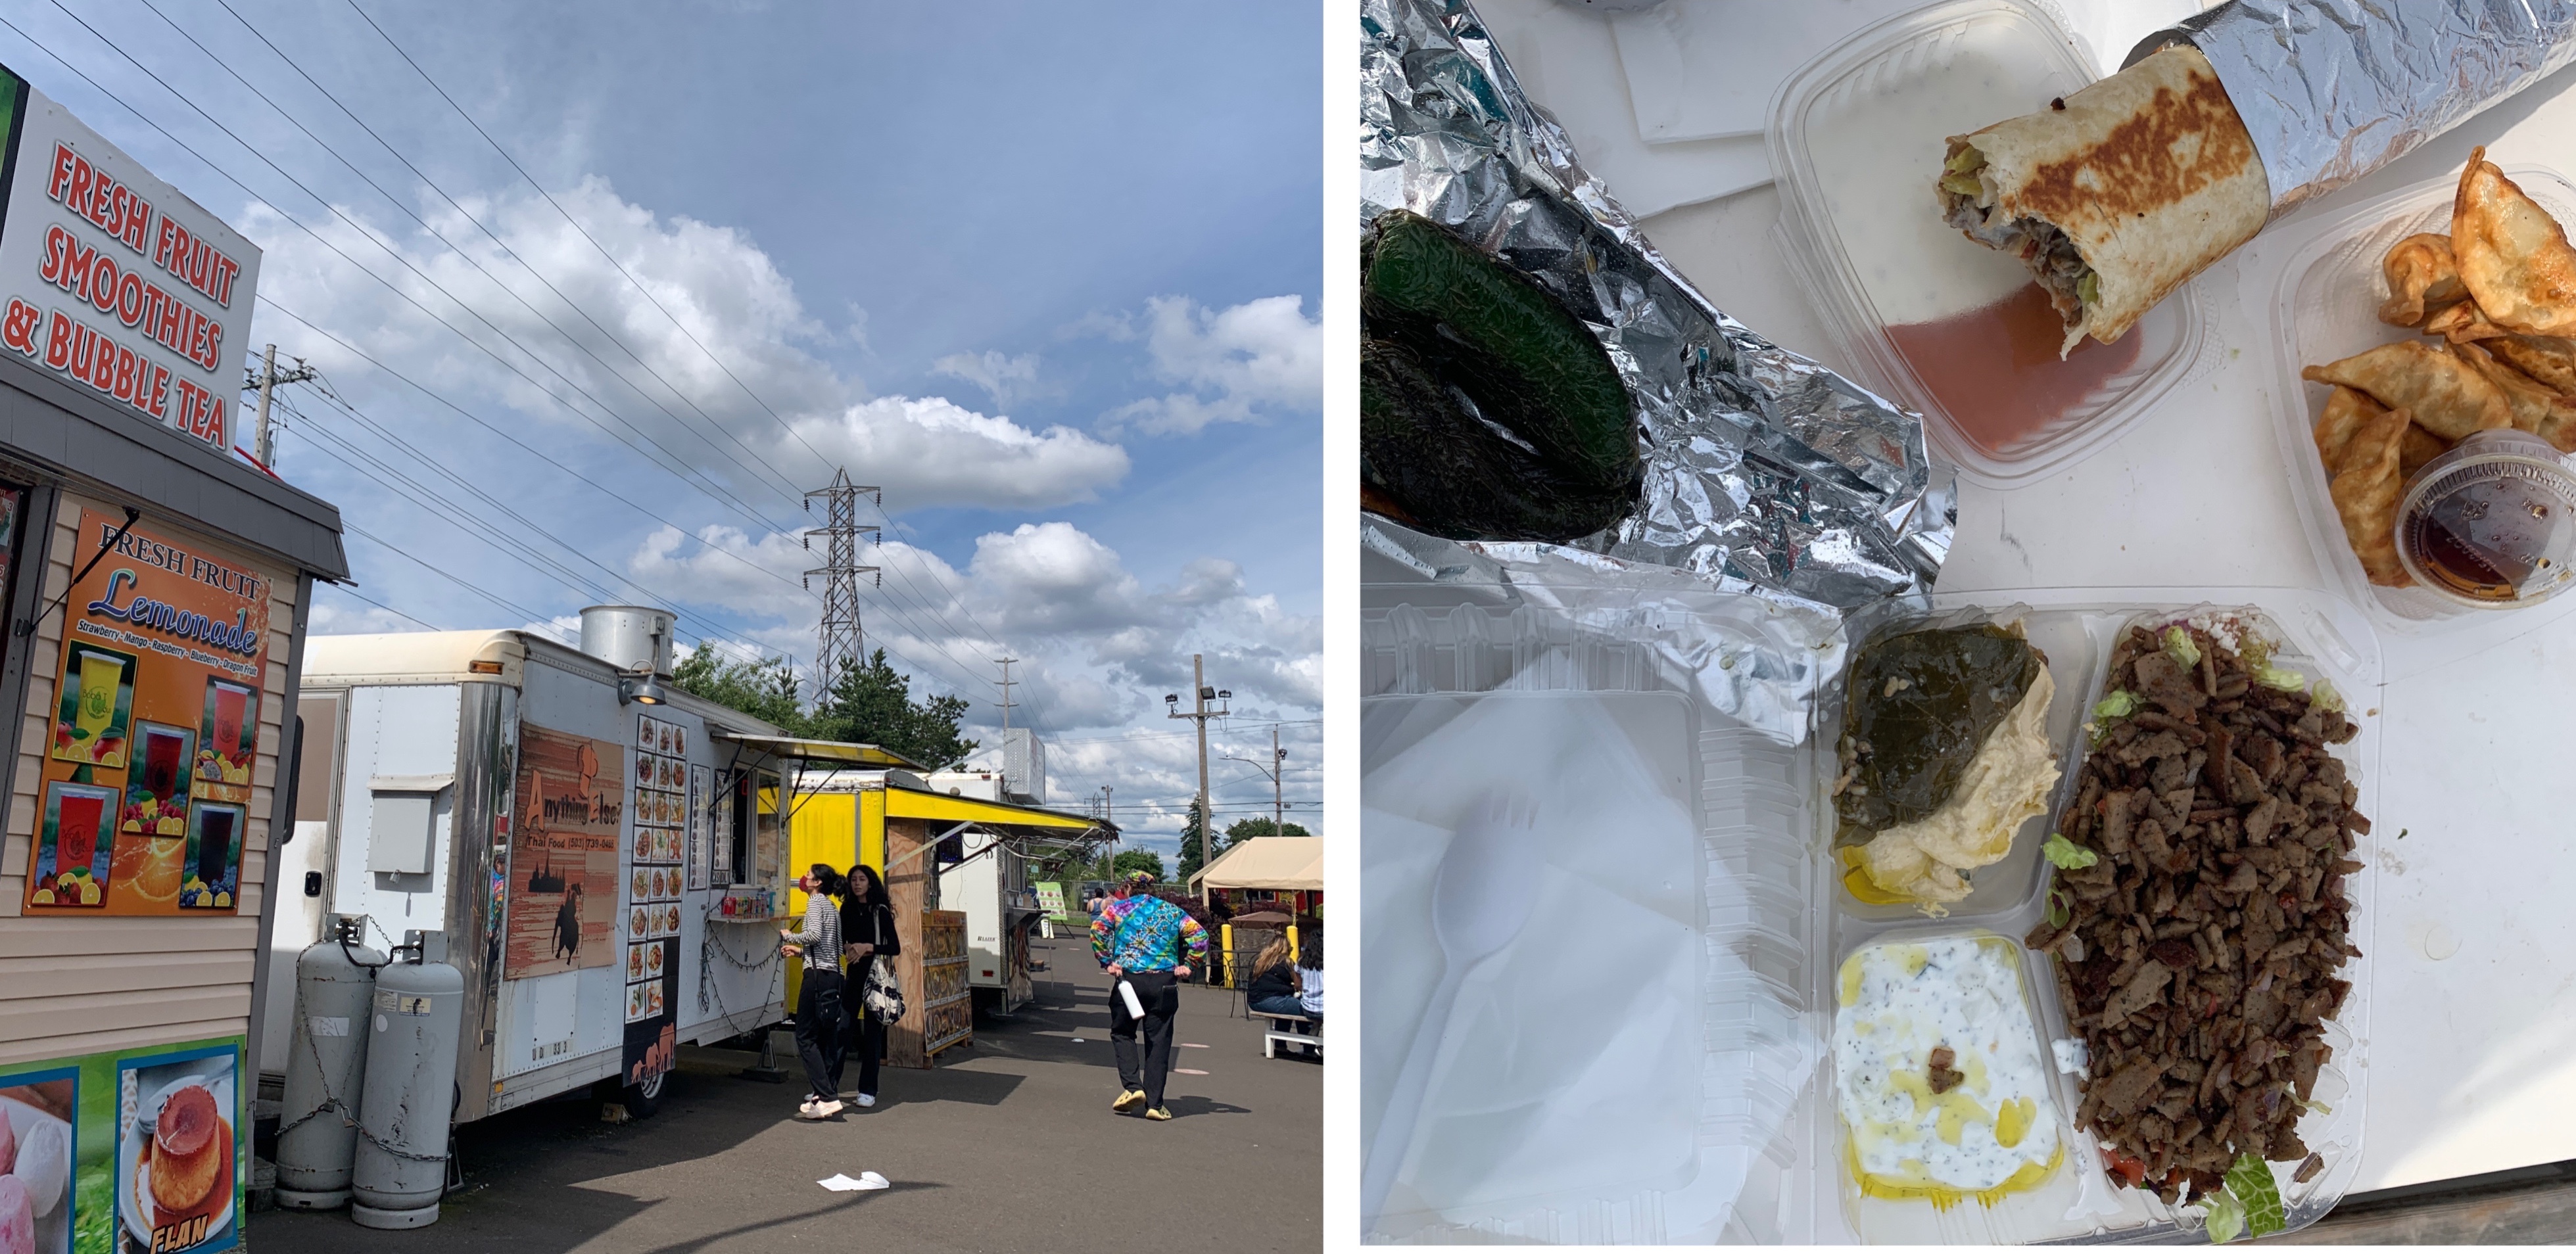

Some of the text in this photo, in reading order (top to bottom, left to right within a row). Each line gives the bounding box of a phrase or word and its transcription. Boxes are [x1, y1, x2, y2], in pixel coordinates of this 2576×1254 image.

[49, 143, 239, 306] FRESH FRUIT
[41, 225, 222, 369] SMOOTHIES
[3, 299, 225, 448] & BUBBLE TEA
[100, 523, 260, 599] FRESH FRUIT
[87, 568, 256, 653] Lemonade
[78, 620, 120, 641] Strawberry
[124, 632, 148, 647] Mango
[152, 639, 185, 657] Raspberry
[191, 649, 220, 667] Blueberry
[223, 659, 244, 672] Dragon
[244, 664, 257, 676] Fruit
[83, 689, 101, 701] Boba
[525, 770, 622, 831] Anything Else?
[527, 833, 546, 847] Thai
[548, 838, 565, 848] Food
[568, 837, 584, 850] (503)
[150, 1213, 210, 1254] FLAN
